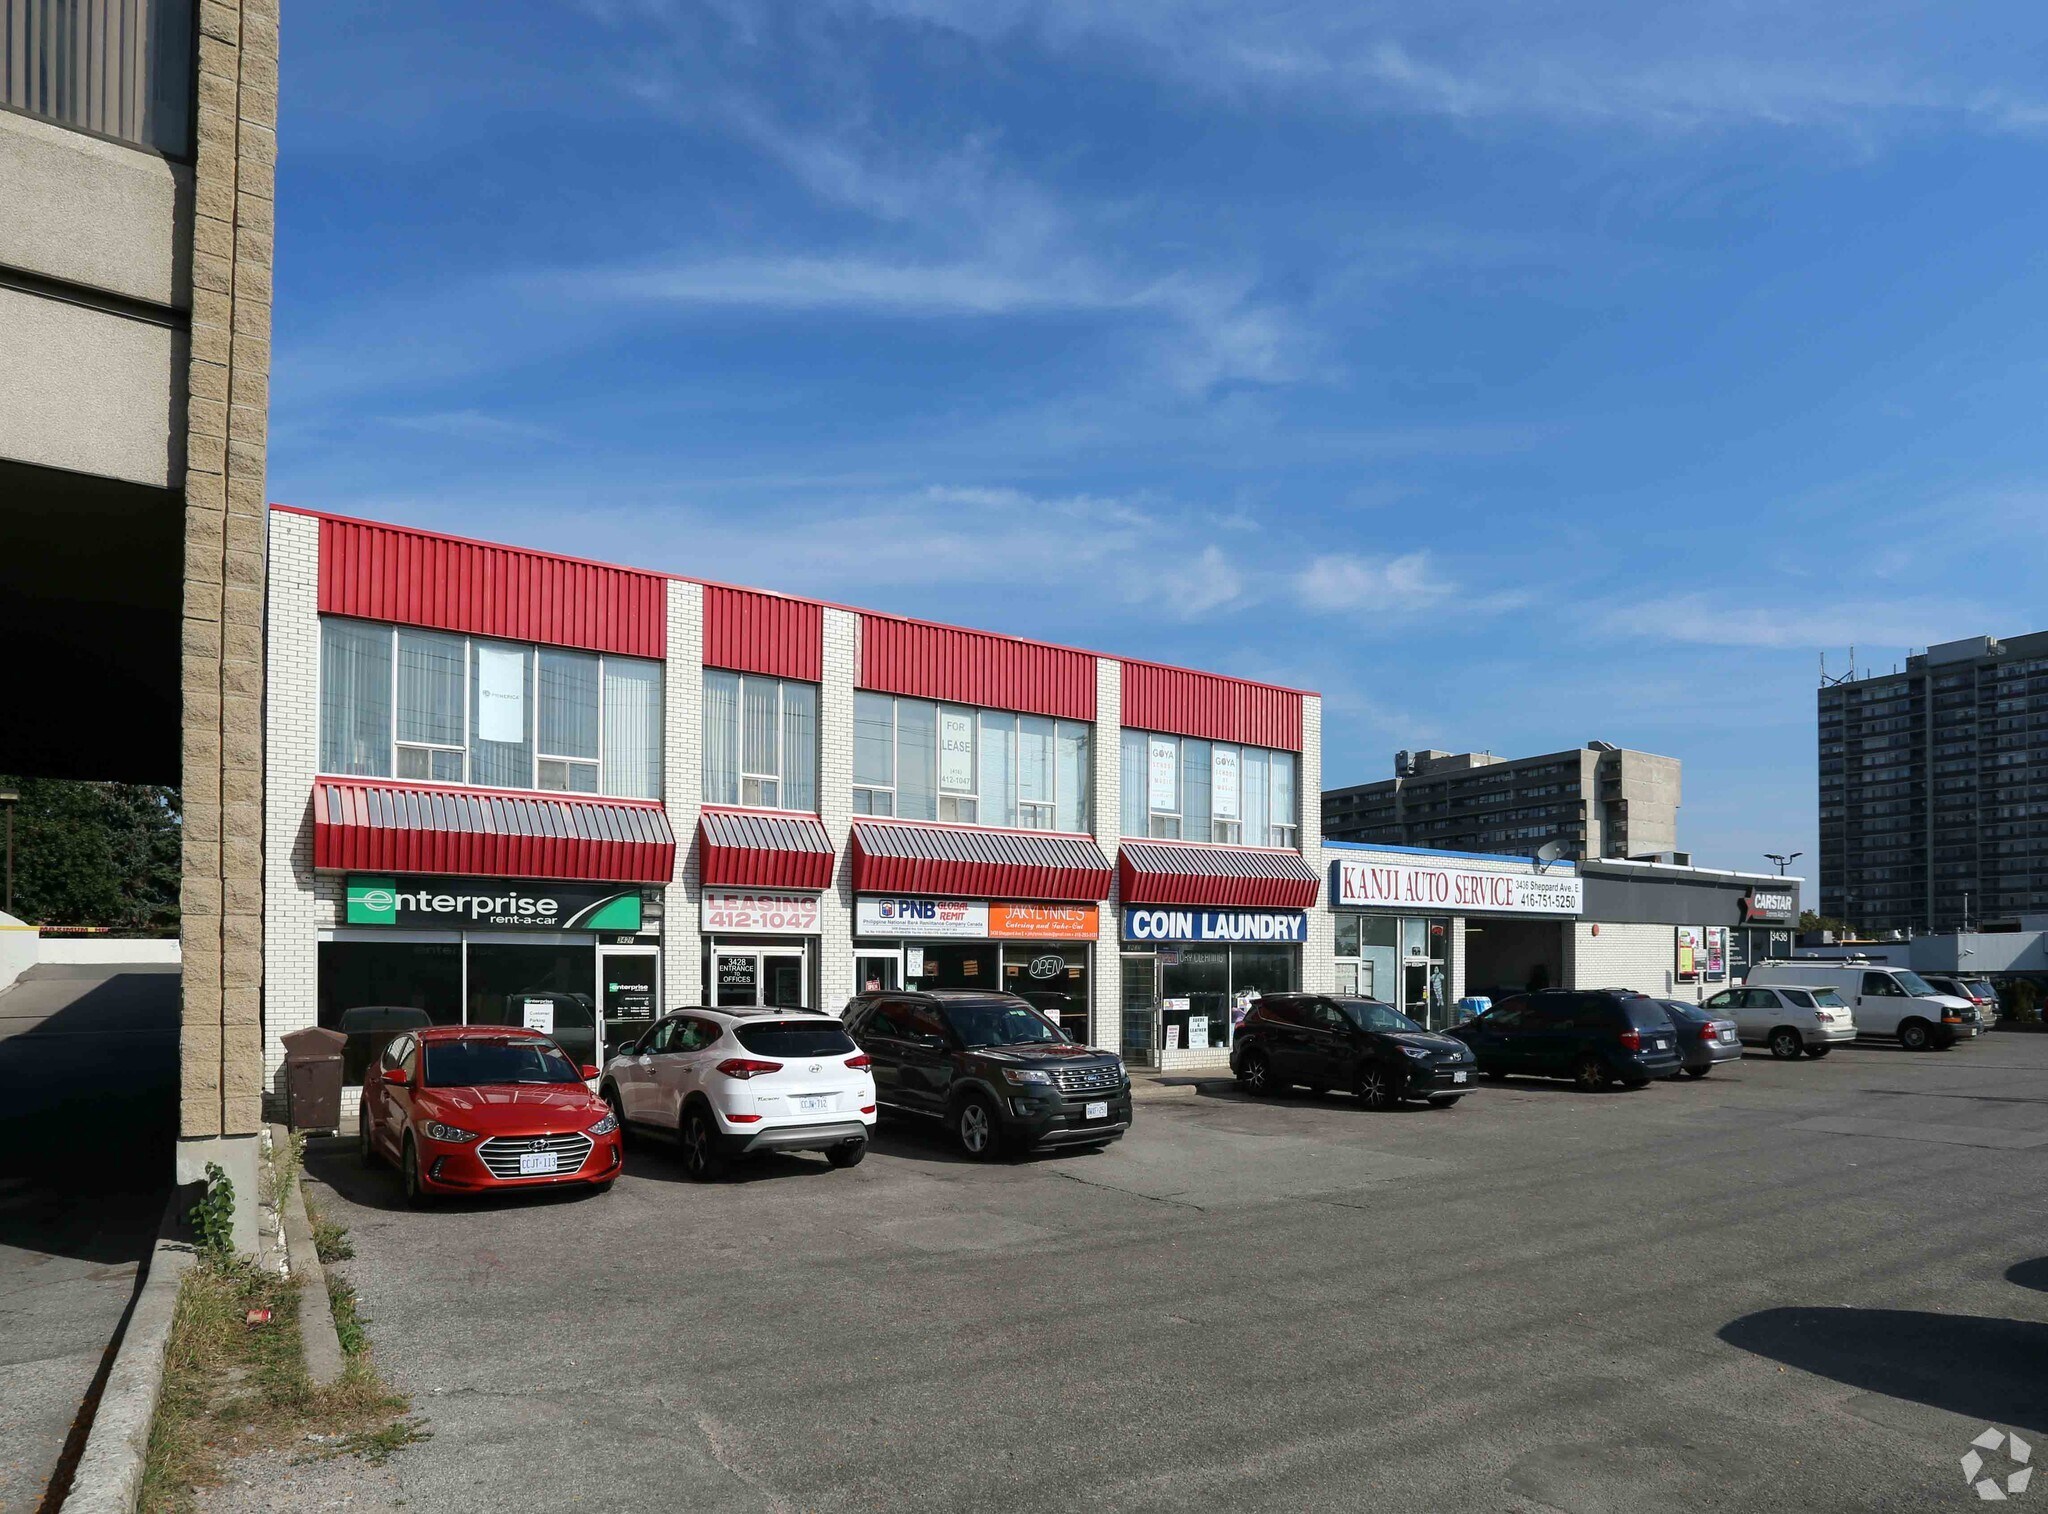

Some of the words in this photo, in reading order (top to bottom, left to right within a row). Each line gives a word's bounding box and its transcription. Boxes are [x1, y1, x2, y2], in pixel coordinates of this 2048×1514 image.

[947, 721, 965, 732] FOR
[942, 740, 971, 753] LEASE
[1152, 748, 1174, 759] GOYA
[1215, 756, 1236, 767] GOYA
[941, 775, 971, 785] 412-1047
[1342, 867, 1400, 900] KANJI
[1405, 871, 1449, 902] AUTO
[1455, 874, 1515, 906] SERVICE
[1516, 879, 1529, 890] 3436
[1530, 880, 1559, 893] Sheppard
[1560, 883, 1574, 893] Ave.
[362, 890, 559, 920] enterprise
[708, 894, 818, 913] LEASING
[937, 901, 969, 911] GLOBAL
[1520, 893, 1576, 909] 416-751-5250
[1754, 893, 1793, 910] CARSTAR
[898, 899, 936, 919] PNB
[1005, 904, 1086, 921] JAKYLYNNE'S
[489, 913, 558, 925] rent-a-car
[708, 911, 817, 929] 412-1047
[940, 911, 965, 921] REMIT
[1005, 921, 1035, 931] Catering
[1132, 910, 1193, 939] COIN
[1202, 912, 1302, 940] LAUNDRY
[1771, 930, 1788, 942] 3438
[728, 958, 747, 966] 3428
[1030, 959, 1062, 975] OPEN
[609, 983, 649, 991] enterprise
